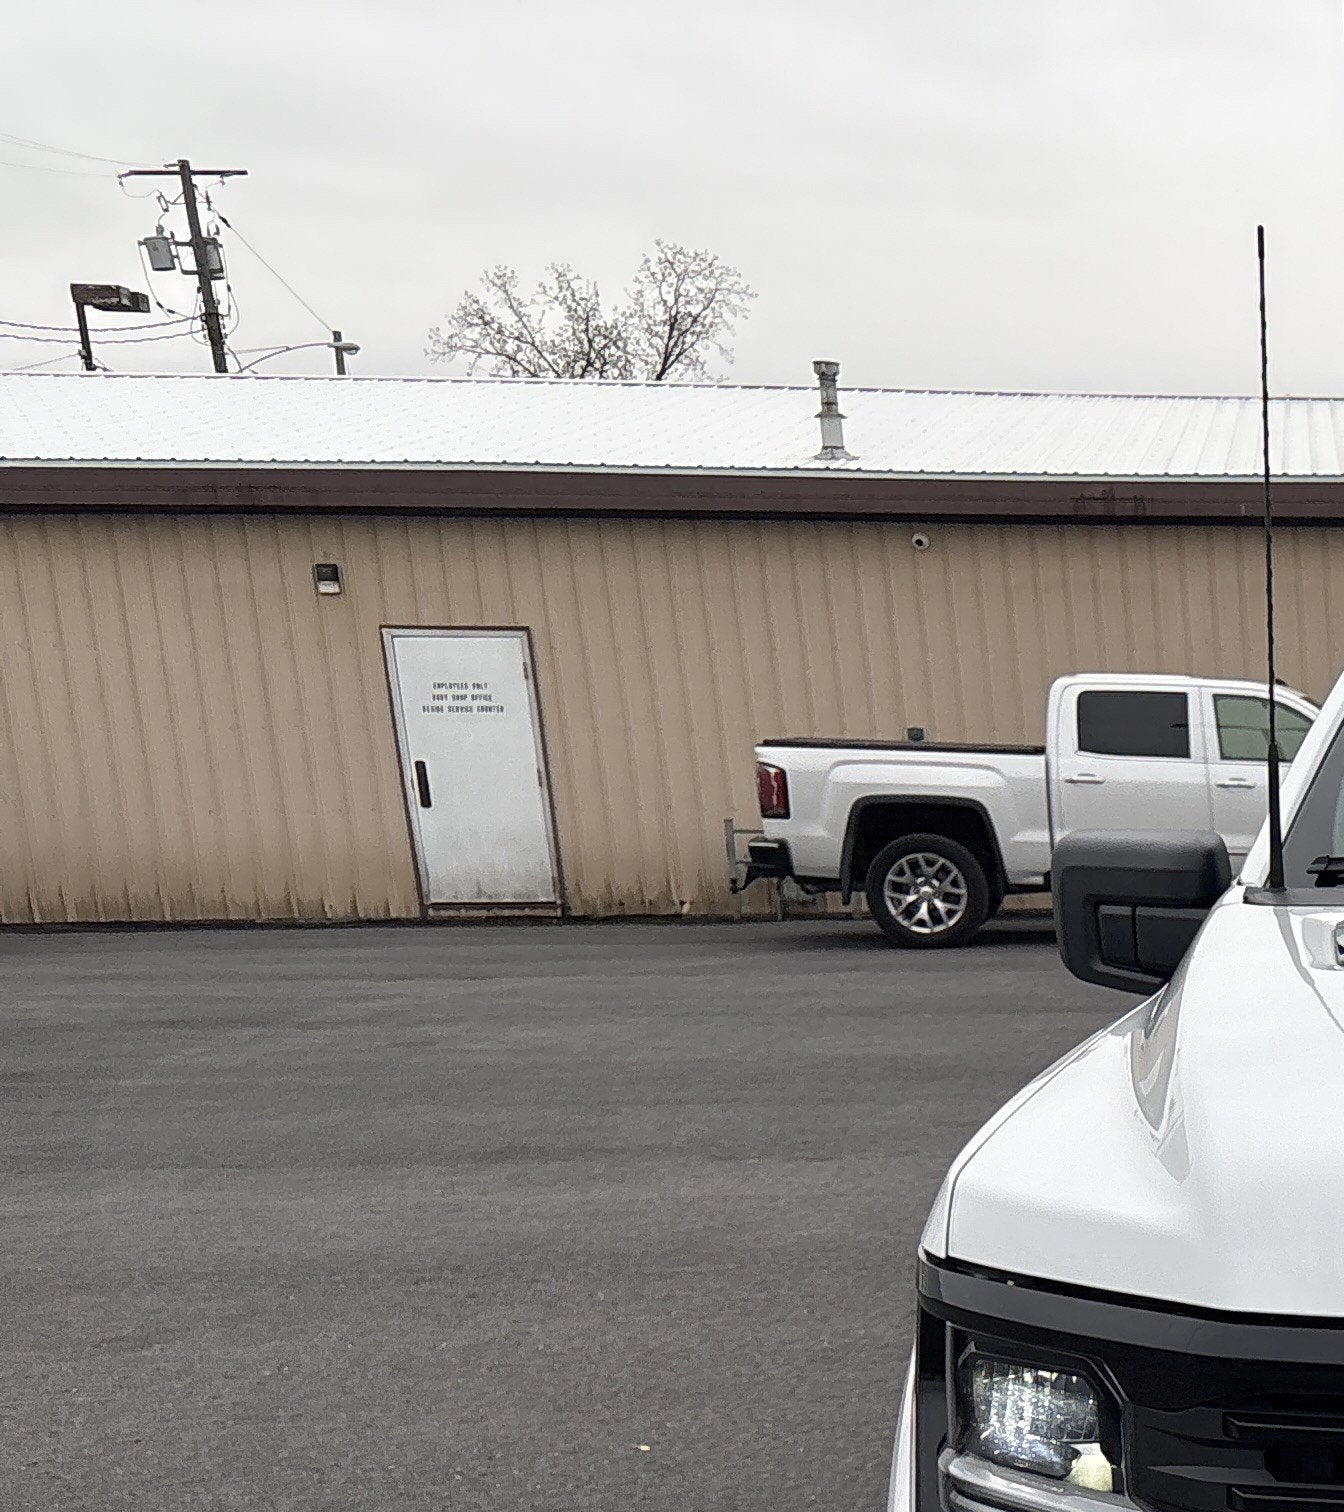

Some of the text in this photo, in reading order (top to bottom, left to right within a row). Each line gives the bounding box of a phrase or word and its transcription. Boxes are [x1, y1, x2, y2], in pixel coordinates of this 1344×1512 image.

[432, 682, 488, 690] EMPLOYEES ONLY
[432, 693, 448, 701] BODY
[471, 694, 492, 702] OFFICE
[477, 705, 504, 713] COUNTER
